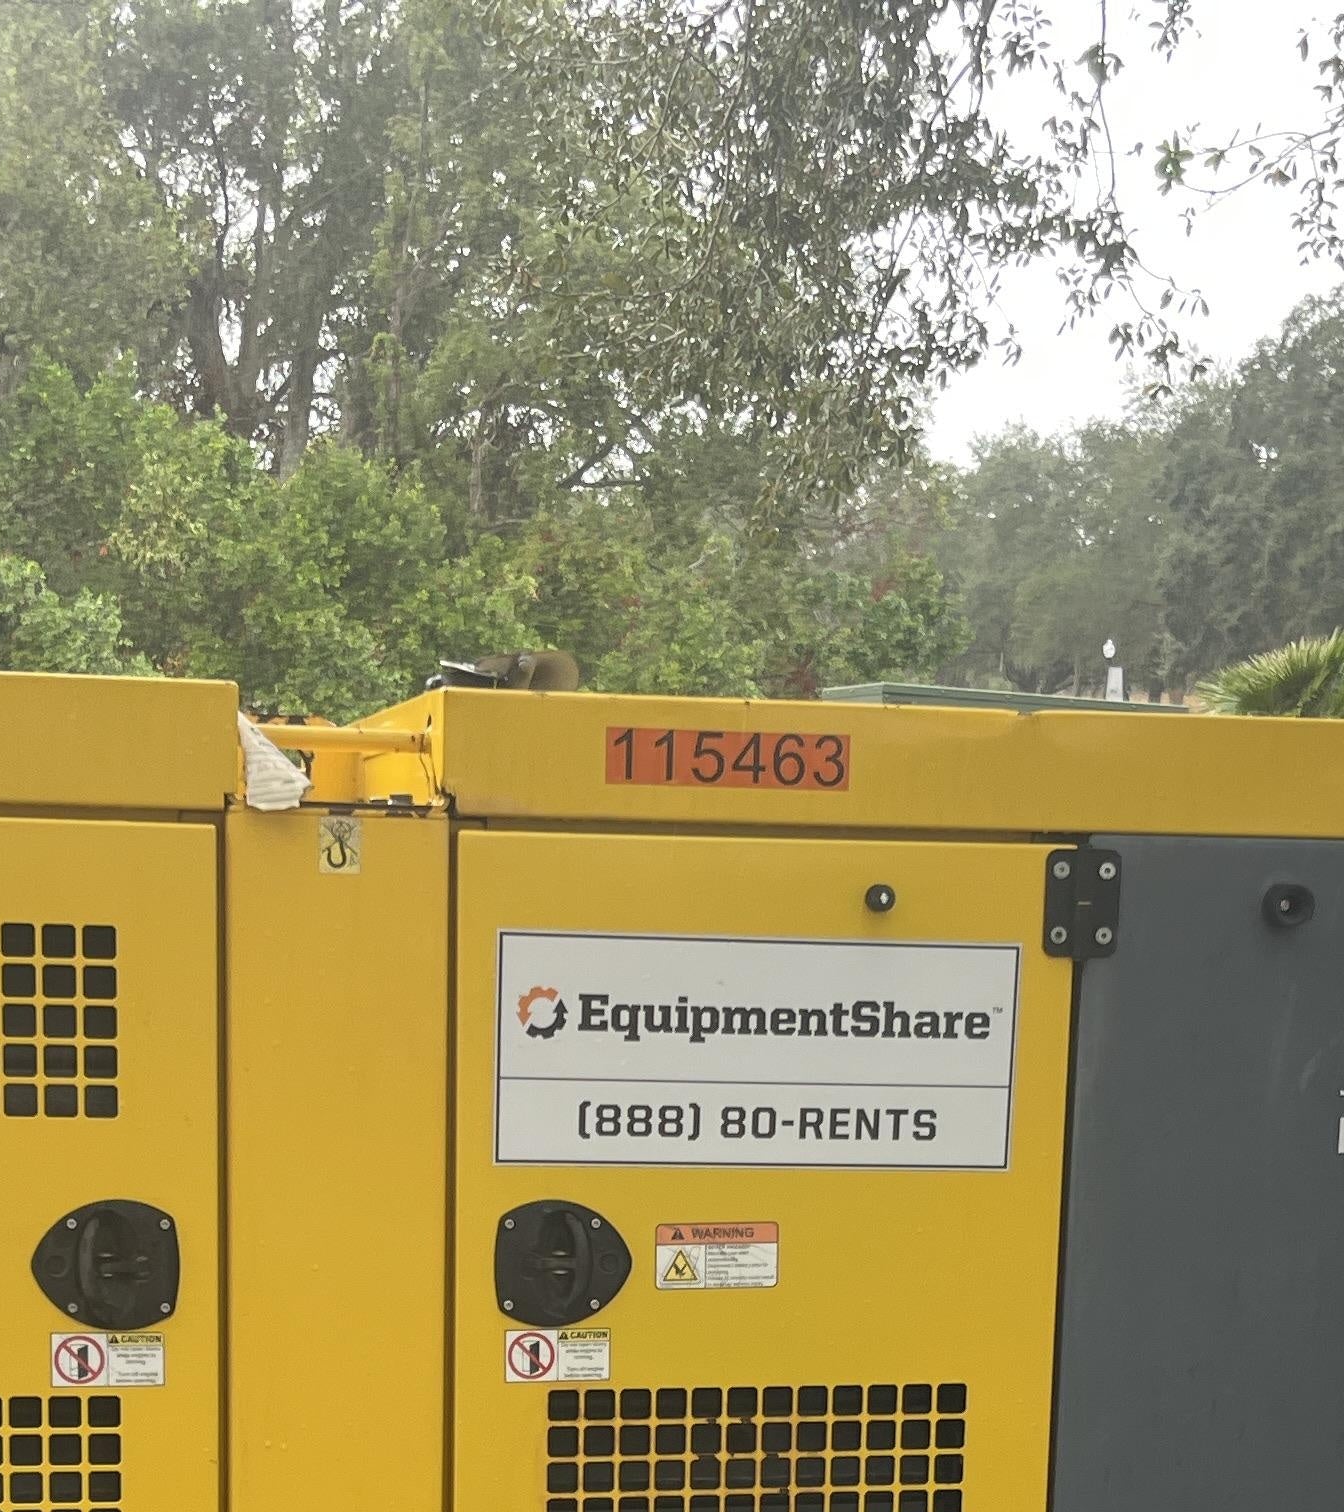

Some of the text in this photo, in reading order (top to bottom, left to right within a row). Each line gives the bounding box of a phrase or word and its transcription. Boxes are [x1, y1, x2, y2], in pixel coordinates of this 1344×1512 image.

[613, 728, 845, 787] 115463
[578, 993, 991, 1043] EquipmentShare
[578, 1101, 938, 1141] (888) 80-RENTS
[691, 1227, 755, 1239] WARNING
[121, 1335, 162, 1343] CAUTION
[570, 1331, 608, 1339] CAUTION
